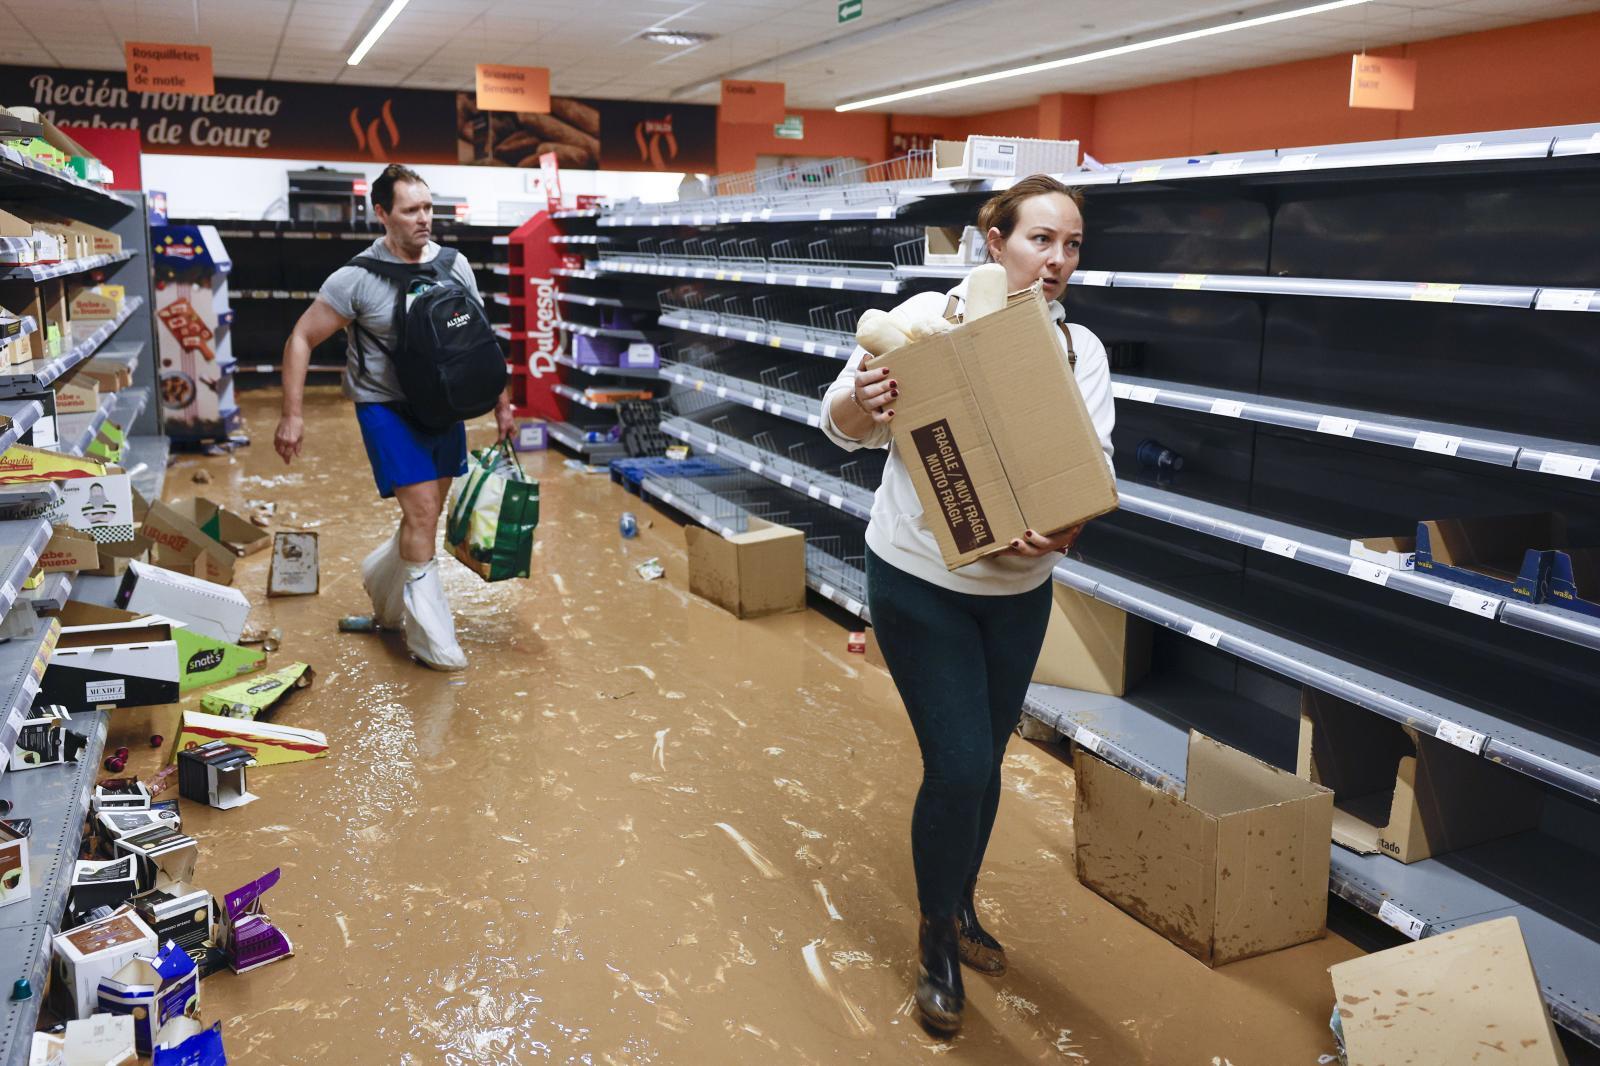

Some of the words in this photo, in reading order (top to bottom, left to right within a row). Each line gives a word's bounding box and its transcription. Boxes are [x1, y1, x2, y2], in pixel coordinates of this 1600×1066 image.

[133, 47, 200, 61] Rosquilletes
[133, 63, 148, 74] Pa
[134, 74, 149, 85] de
[29, 74, 129, 108] Recién
[140, 89, 281, 116] Horneado
[147, 116, 181, 145] de
[190, 117, 271, 148] Coure
[528, 278, 555, 378] Dulcesol
[925, 453, 947, 489] MUITO
[940, 489, 964, 528] FRÁGIL
[932, 425, 959, 471] FRAGILE
[953, 480, 972, 503] MUY
[963, 504, 987, 543] FRÁGIL
[39, 558, 77, 567] bueno
[189, 652, 221, 670] snatt's
